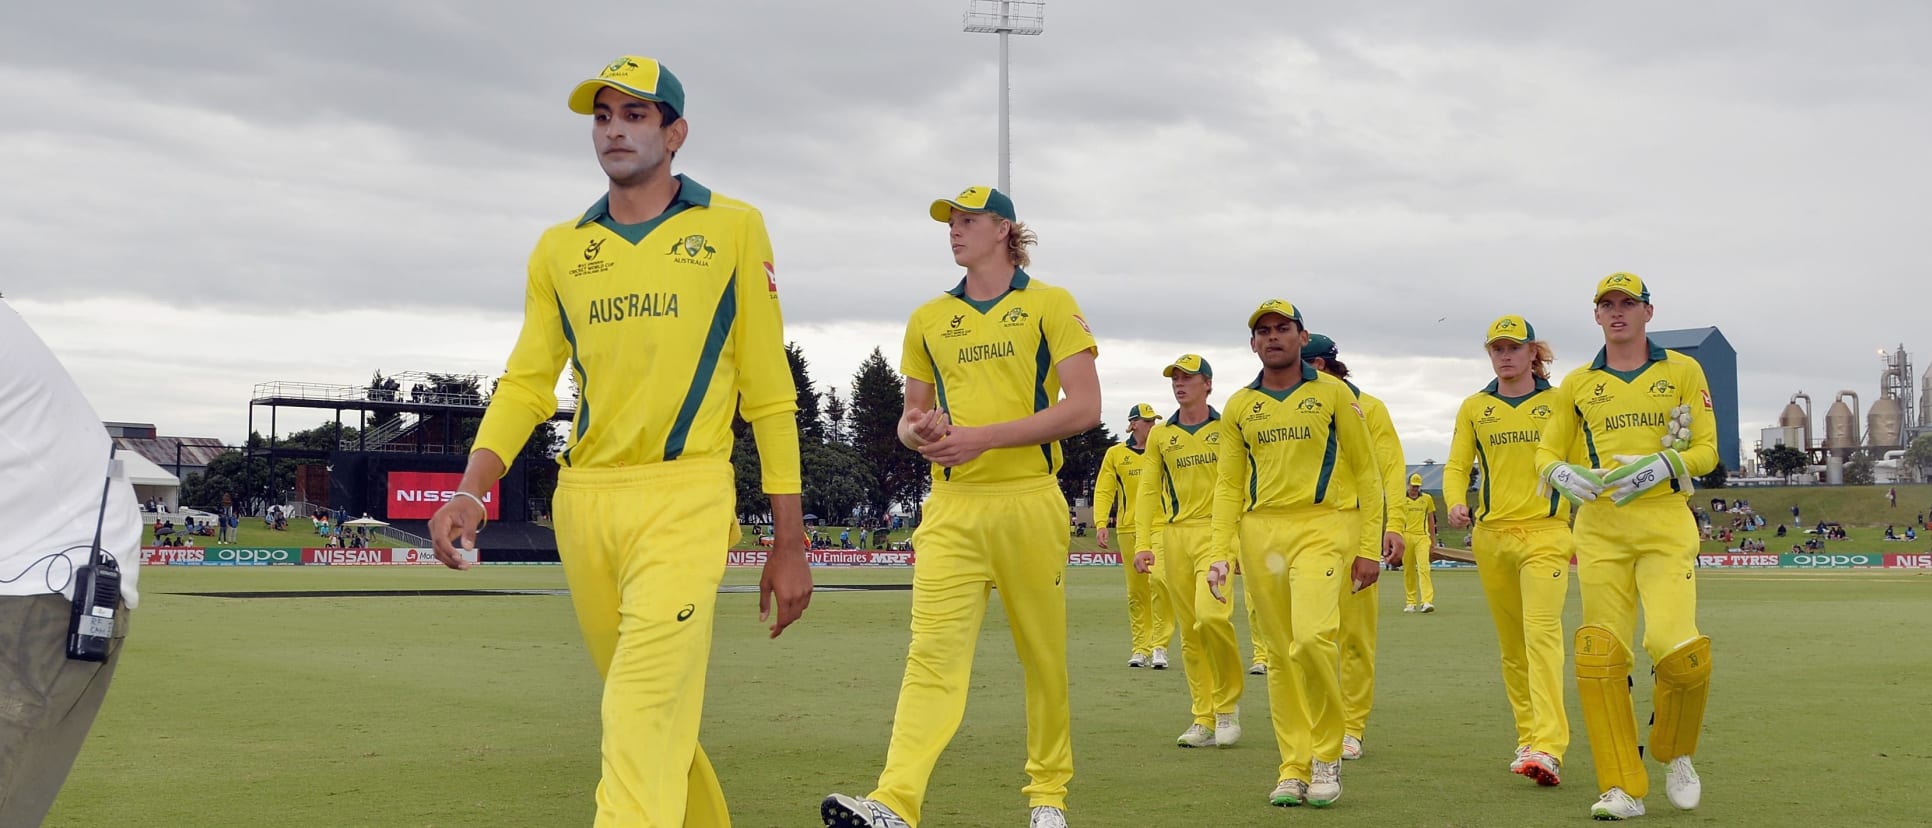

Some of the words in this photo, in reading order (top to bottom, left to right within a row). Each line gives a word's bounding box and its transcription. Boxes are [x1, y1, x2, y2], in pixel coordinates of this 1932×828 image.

[589, 292, 679, 325] AUSRALIA
[957, 341, 1015, 364] AUSTRALIA
[1605, 412, 1665, 431] AUSTRALIA
[1257, 426, 1311, 444] AUSTRALIA
[1489, 430, 1541, 447] AUSTRALIA
[1176, 452, 1218, 469] AUSTRALIA
[396, 490, 491, 502] NISSN
[159, 549, 204, 562] TYRES
[314, 550, 381, 563] NISSAN
[805, 552, 822, 563] Fly
[823, 551, 867, 563] Emirates
[870, 553, 911, 563] MRF
[1695, 555, 1728, 566] RF
[1730, 555, 1778, 566] TYRES
